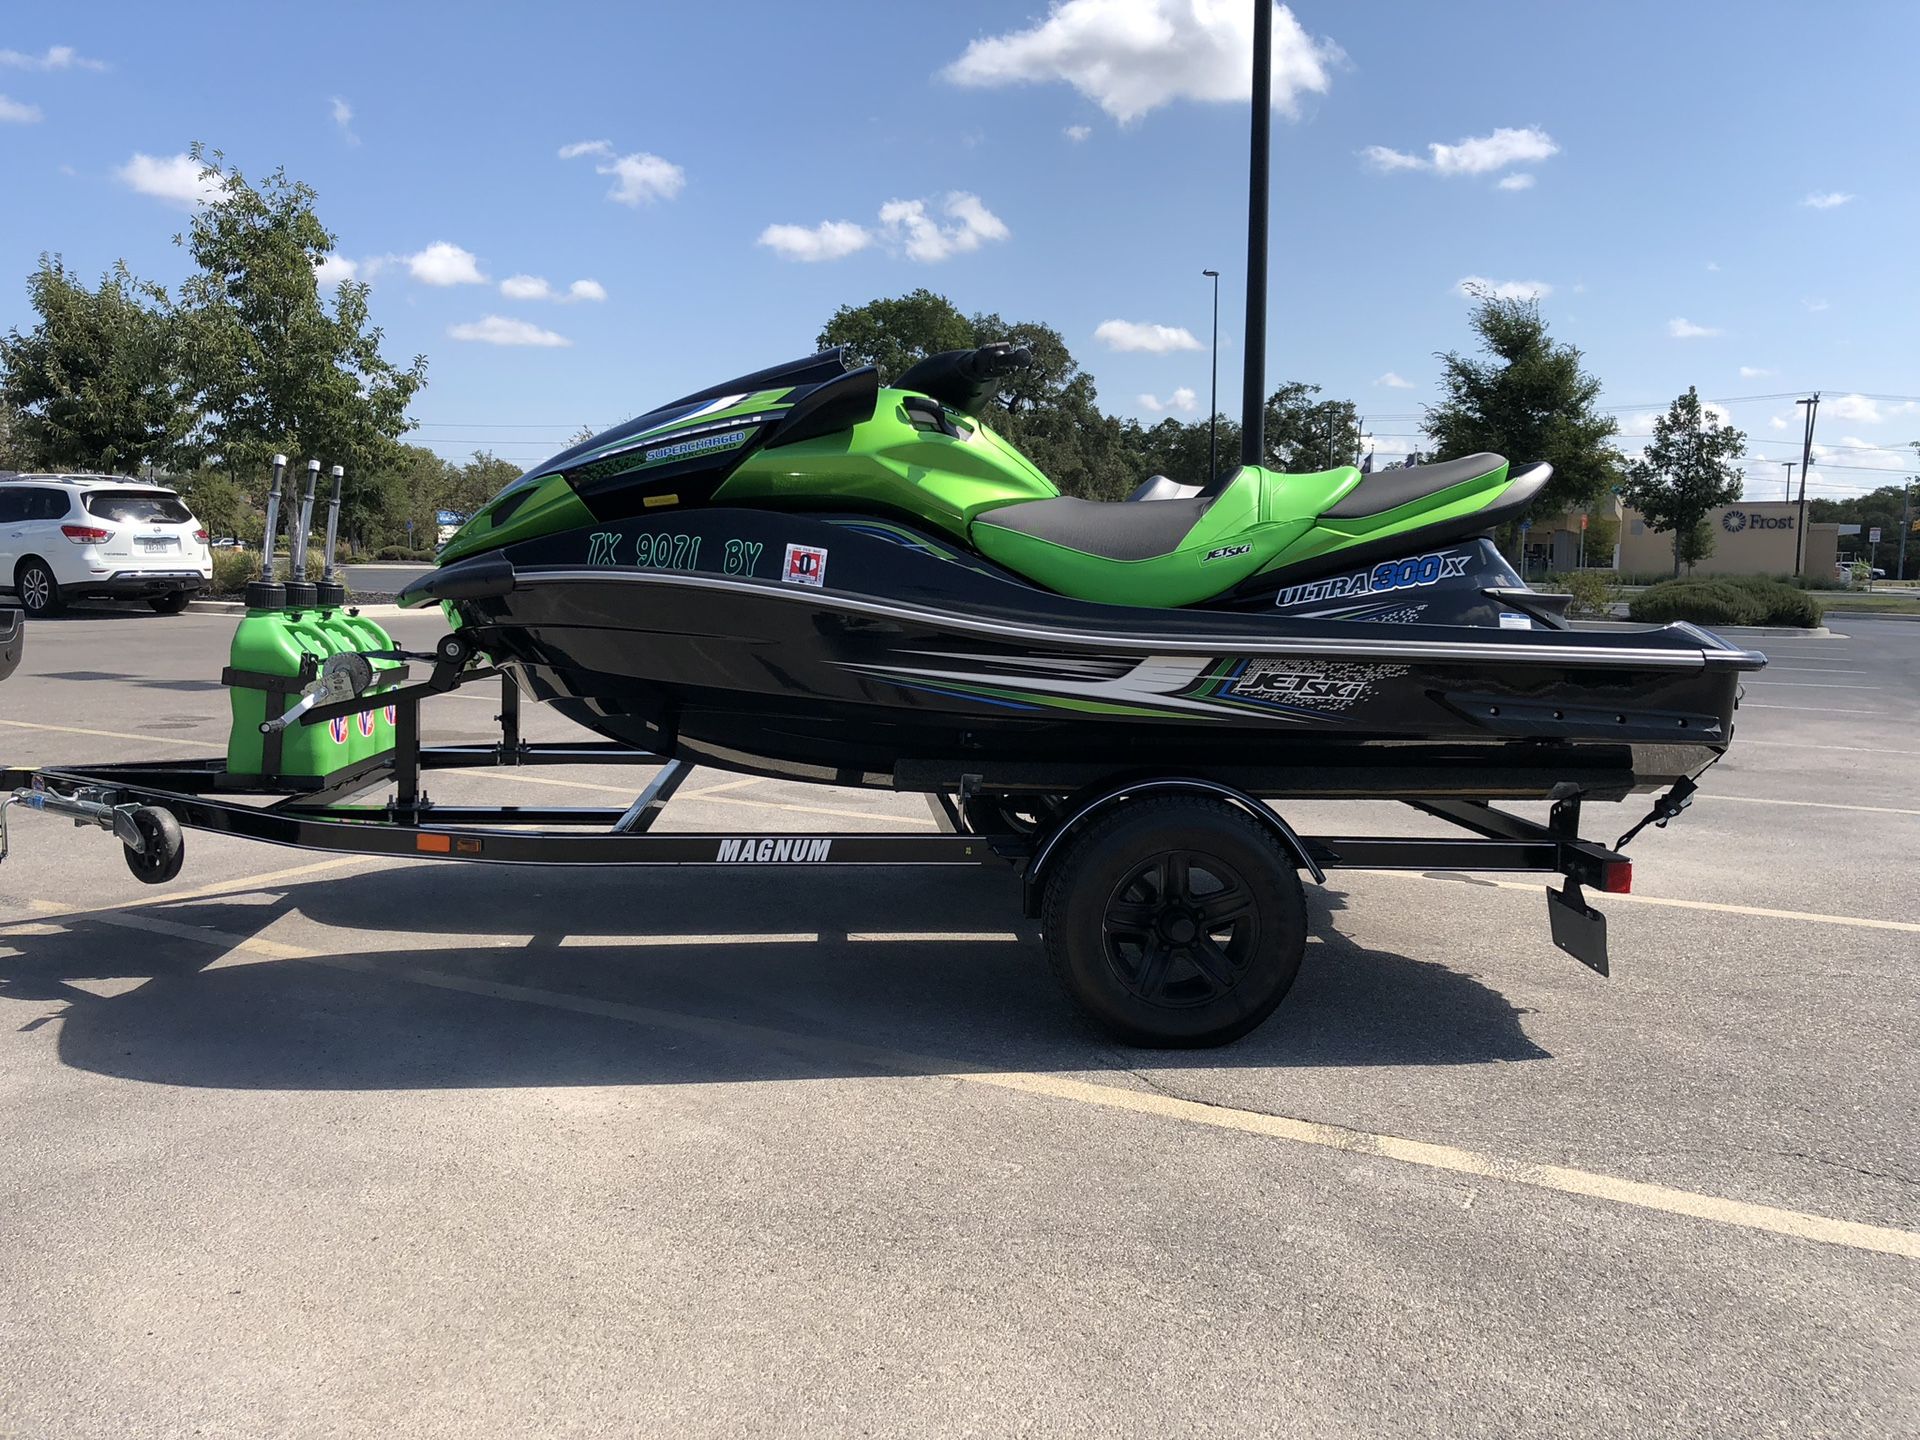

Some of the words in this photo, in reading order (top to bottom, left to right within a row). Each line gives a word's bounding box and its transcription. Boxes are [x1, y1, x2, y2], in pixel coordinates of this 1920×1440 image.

[646, 432, 745, 461] SUPERCHARGED
[665, 443, 737, 462] INTERCOOLED
[1750, 514, 1794, 529] Frost
[587, 532, 622, 566] TX
[636, 533, 701, 571] 9071
[723, 539, 763, 577] BY
[1276, 573, 1369, 606] ULTRA
[716, 839, 832, 862] MAGNUM
